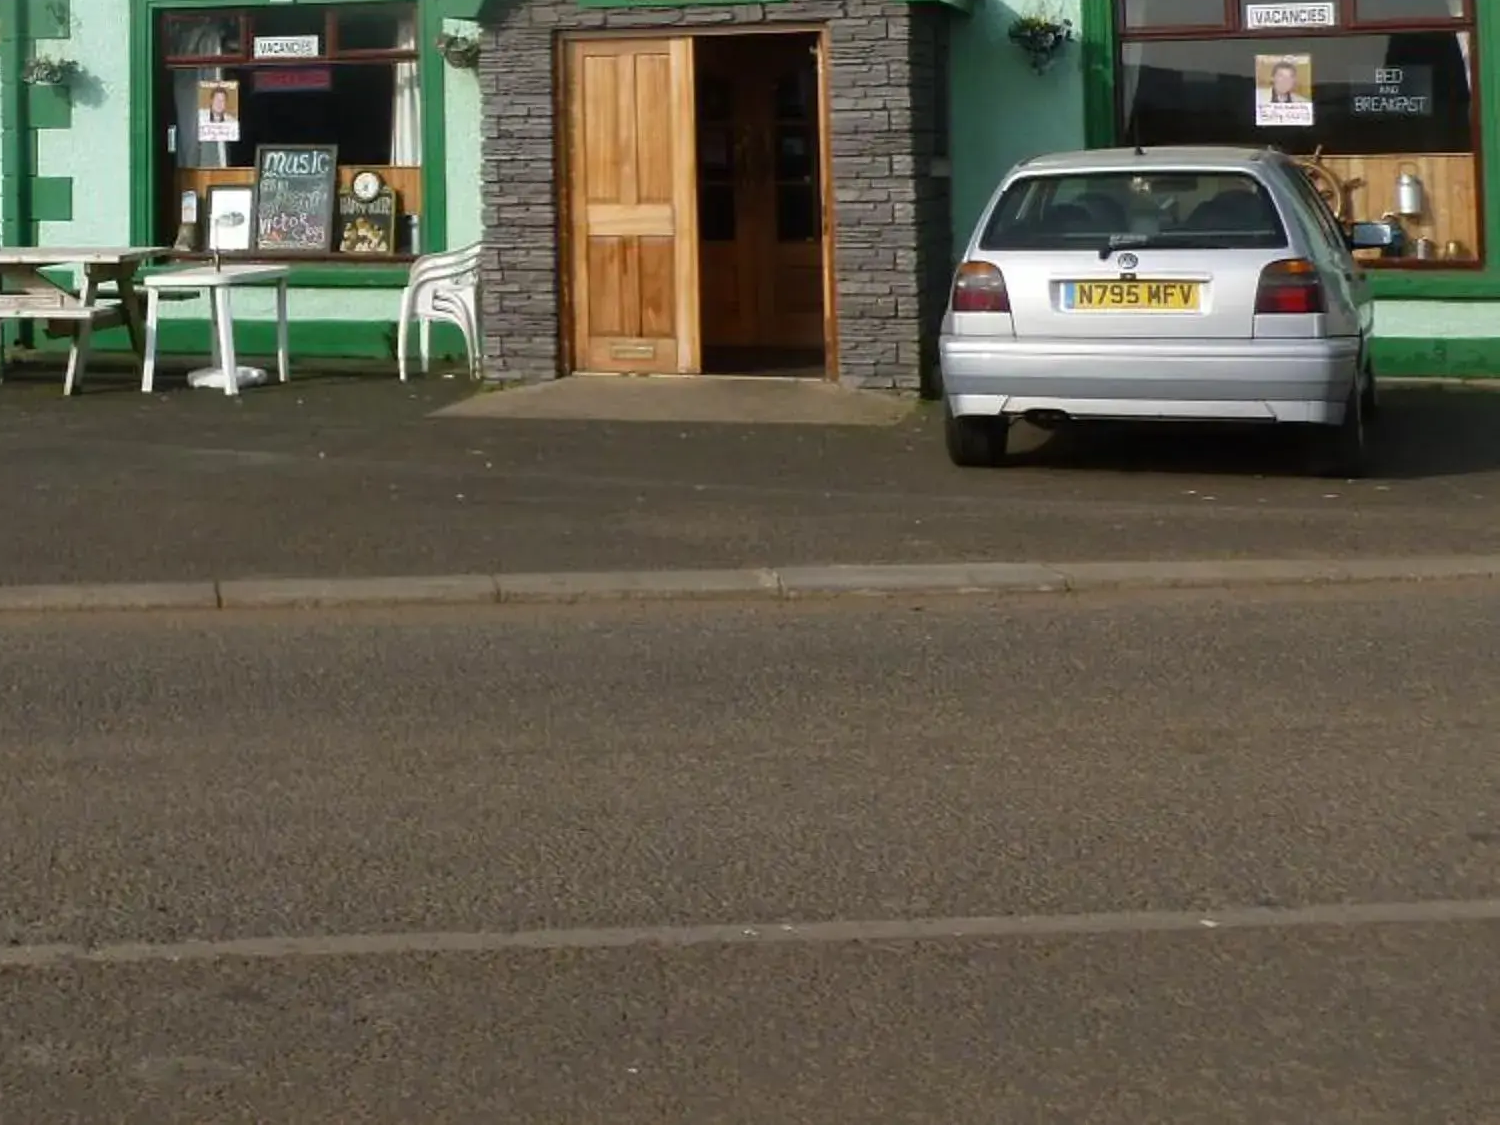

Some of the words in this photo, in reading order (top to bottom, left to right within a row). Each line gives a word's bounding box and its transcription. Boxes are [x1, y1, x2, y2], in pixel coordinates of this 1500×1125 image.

[1255, 8, 1327, 25] VACANCIES
[1374, 69, 1404, 84] BED
[1354, 96, 1429, 112] BREAKFAST
[1079, 284, 1140, 305] N795
[1147, 284, 1193, 305] MFV
